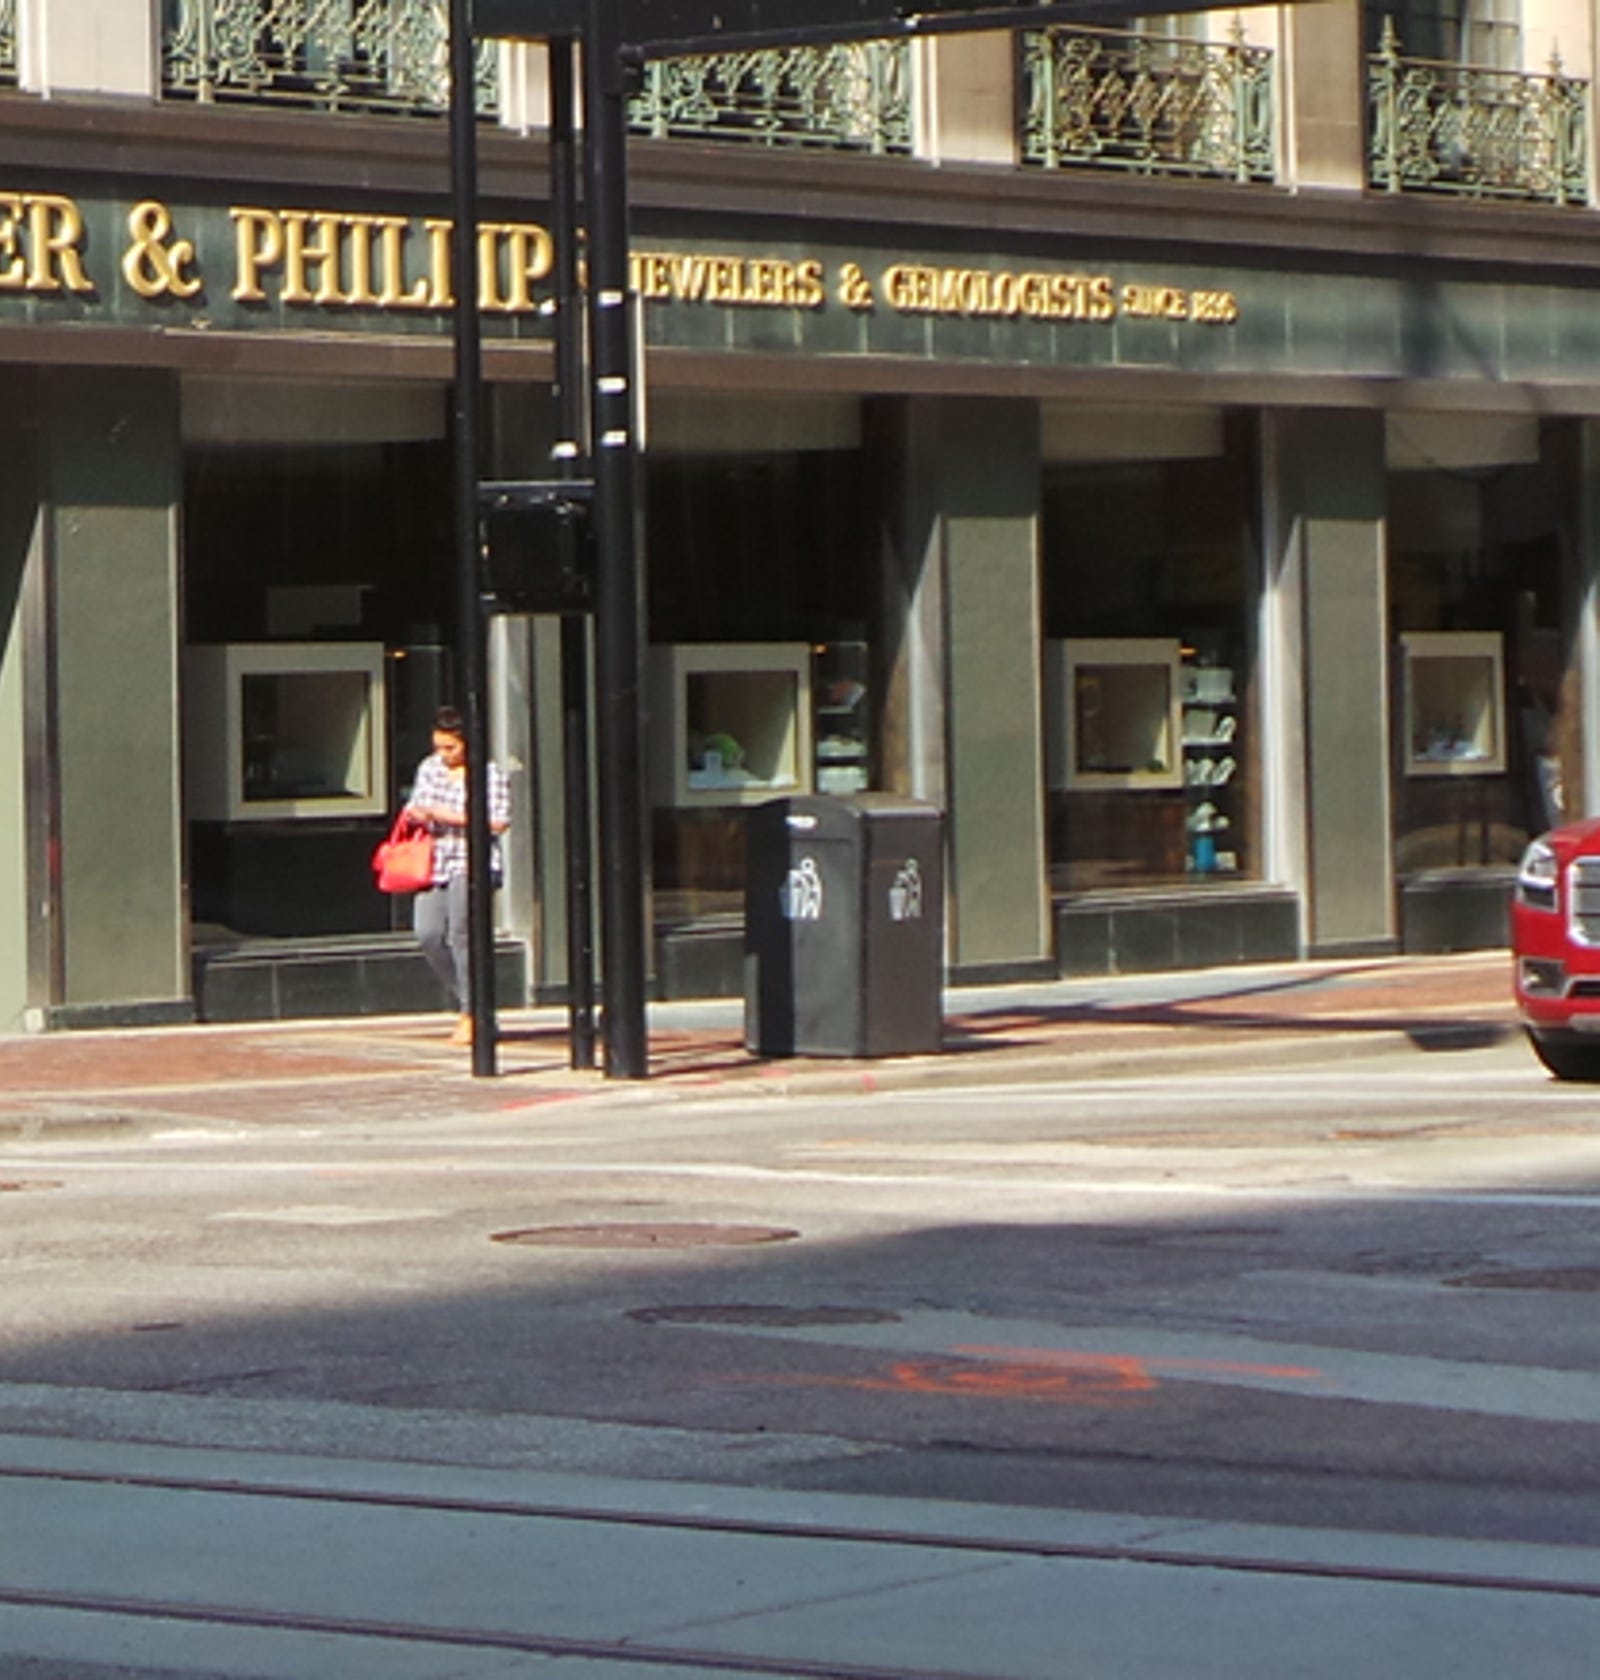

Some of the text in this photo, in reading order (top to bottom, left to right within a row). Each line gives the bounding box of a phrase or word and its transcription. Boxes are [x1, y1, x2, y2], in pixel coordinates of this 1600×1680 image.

[122, 200, 202, 298] &
[229, 206, 588, 313] PHILLIP
[838, 263, 873, 308] &
[882, 263, 1115, 319] GEMOLOGISTS
